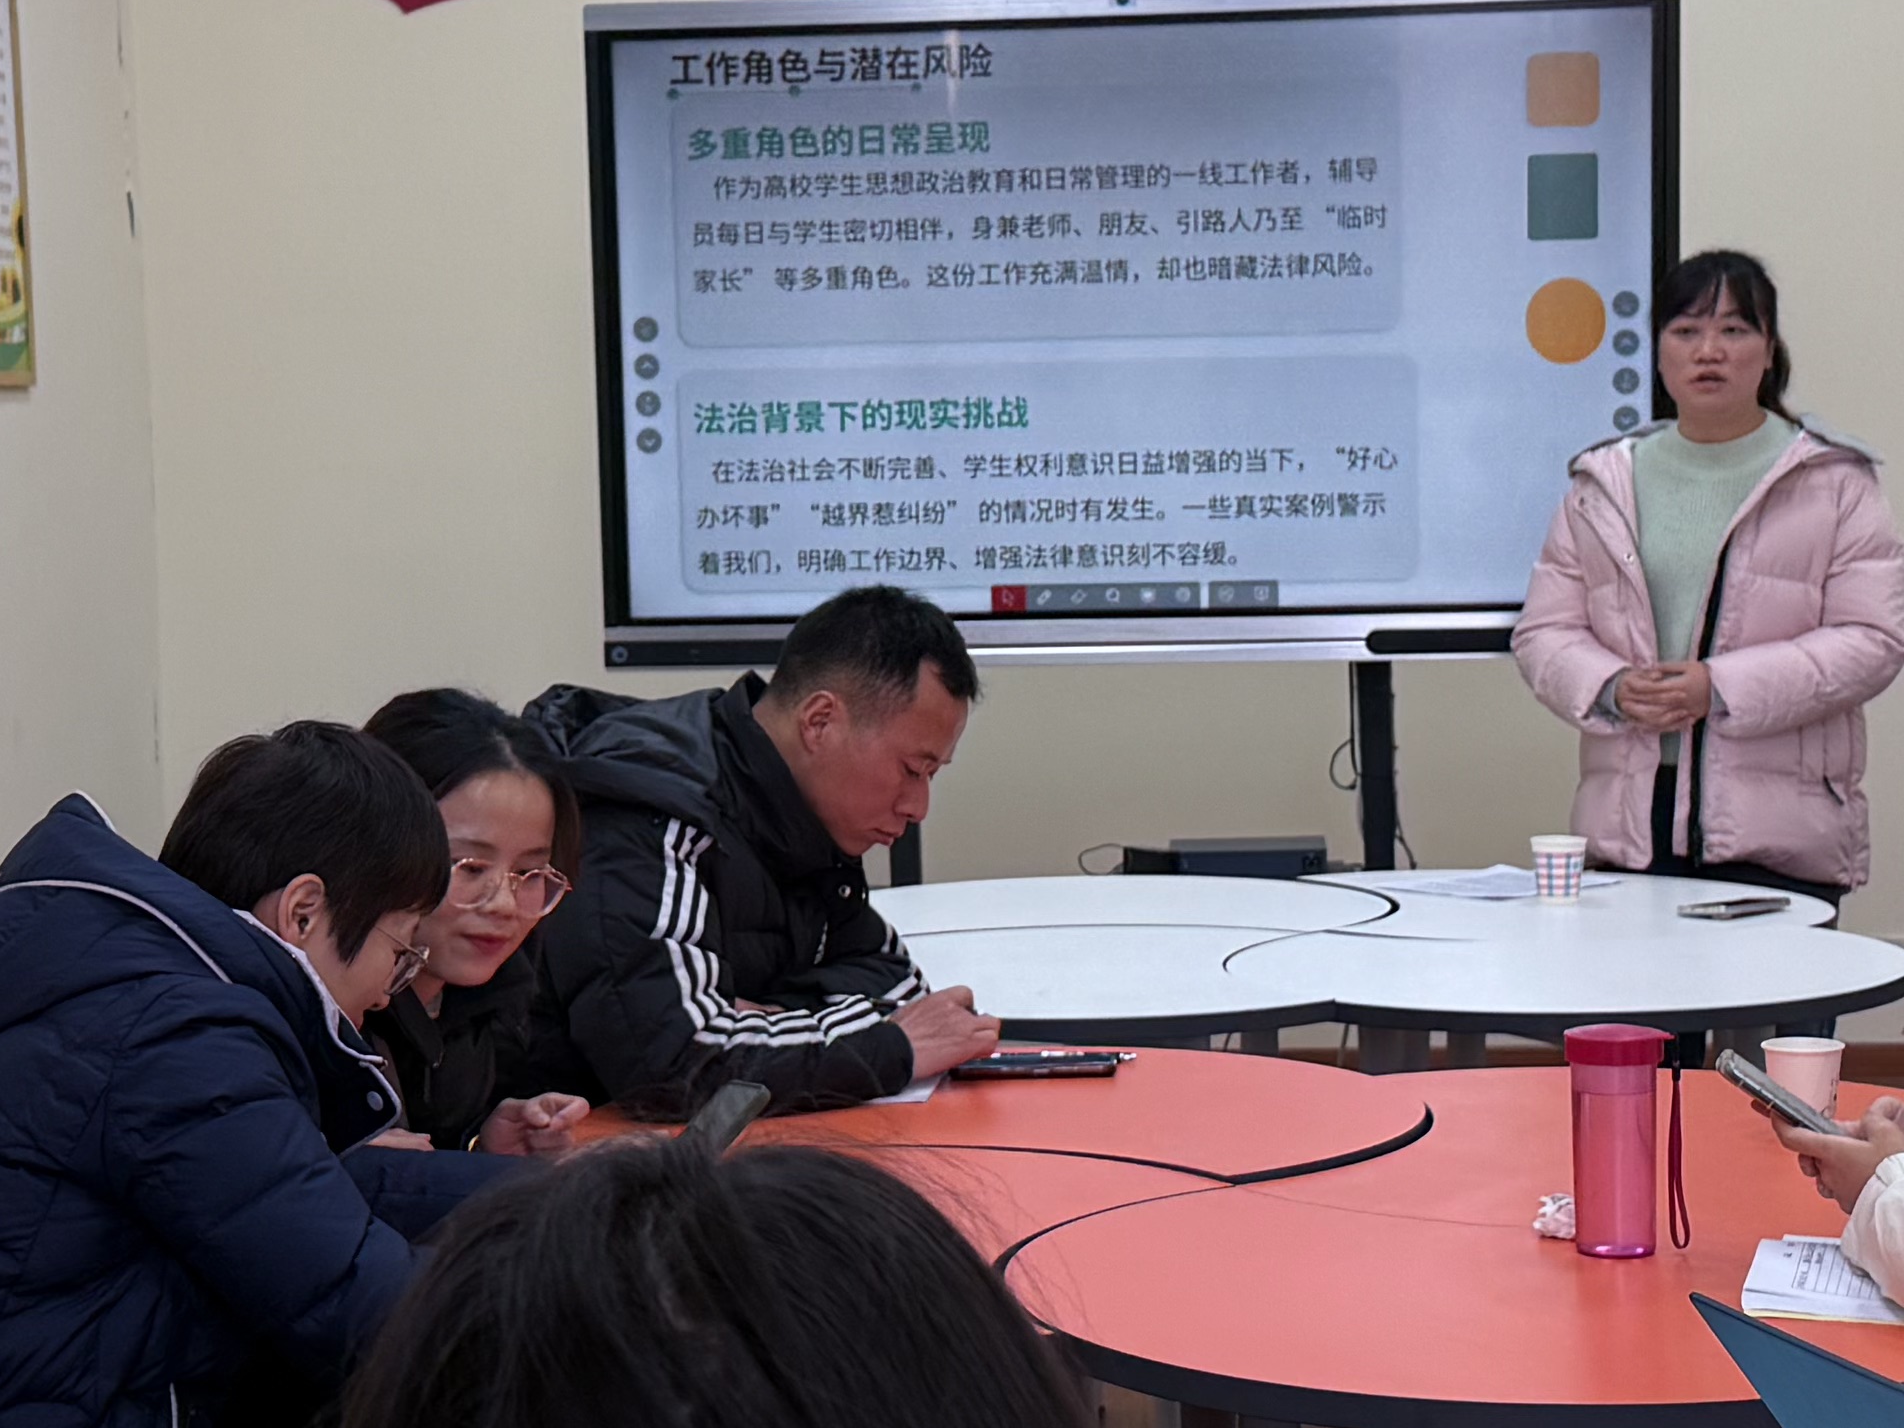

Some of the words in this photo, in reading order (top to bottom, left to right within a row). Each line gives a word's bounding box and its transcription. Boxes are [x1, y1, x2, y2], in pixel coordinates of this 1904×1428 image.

[669, 42, 994, 87] 工作角色与潜在风险
[687, 120, 991, 162] 多重角色的日常呈现
[692, 394, 1030, 437] 法治背景下的现实挑战
